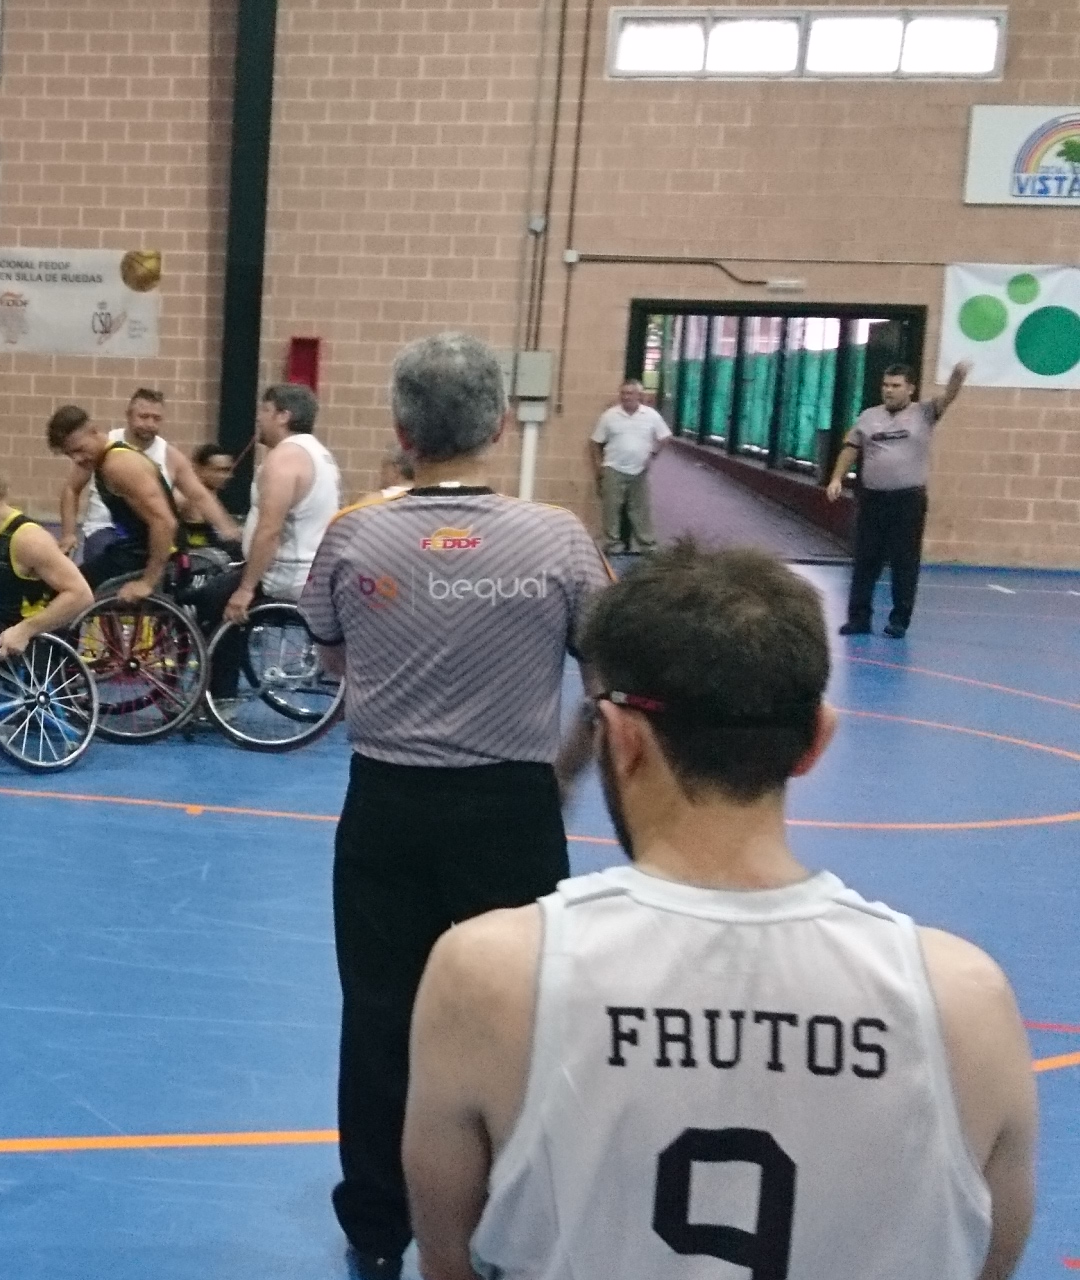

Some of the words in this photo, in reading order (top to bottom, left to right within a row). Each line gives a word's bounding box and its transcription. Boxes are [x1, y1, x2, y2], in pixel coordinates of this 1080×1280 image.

[15, 272, 43, 283] SILLA
[45, 273, 58, 283] DE
[60, 274, 104, 284] RUEDAS
[421, 537, 482, 550] FEDDF
[427, 571, 549, 607] bequal
[605, 1004, 889, 1080] FRUTOS
